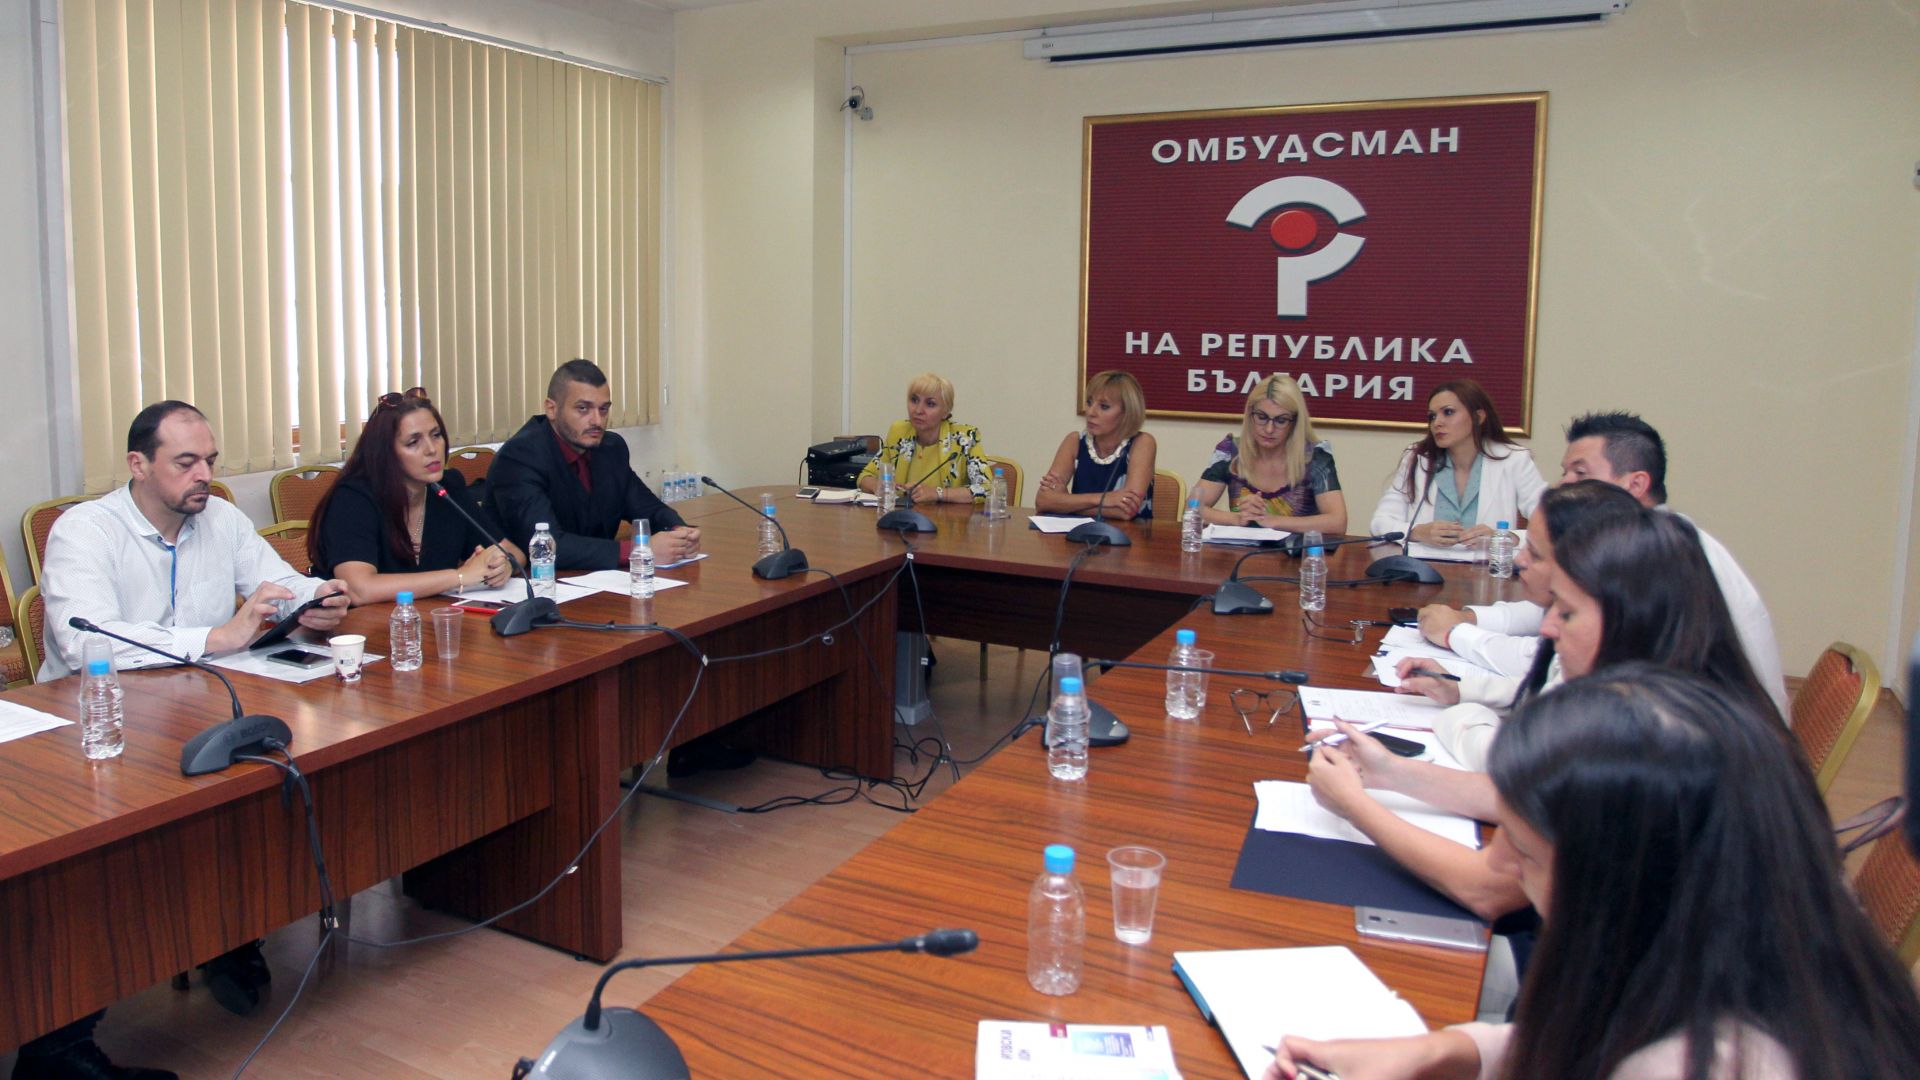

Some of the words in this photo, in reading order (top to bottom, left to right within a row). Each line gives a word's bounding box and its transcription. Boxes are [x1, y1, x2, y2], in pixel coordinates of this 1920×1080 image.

[1151, 127, 1459, 163] ОМБУДСМАН
[1125, 331, 1180, 355] НА
[1201, 333, 1473, 363] РЕПУБЛИКА
[1187, 369, 1413, 400] БЪЛАРИЯ
